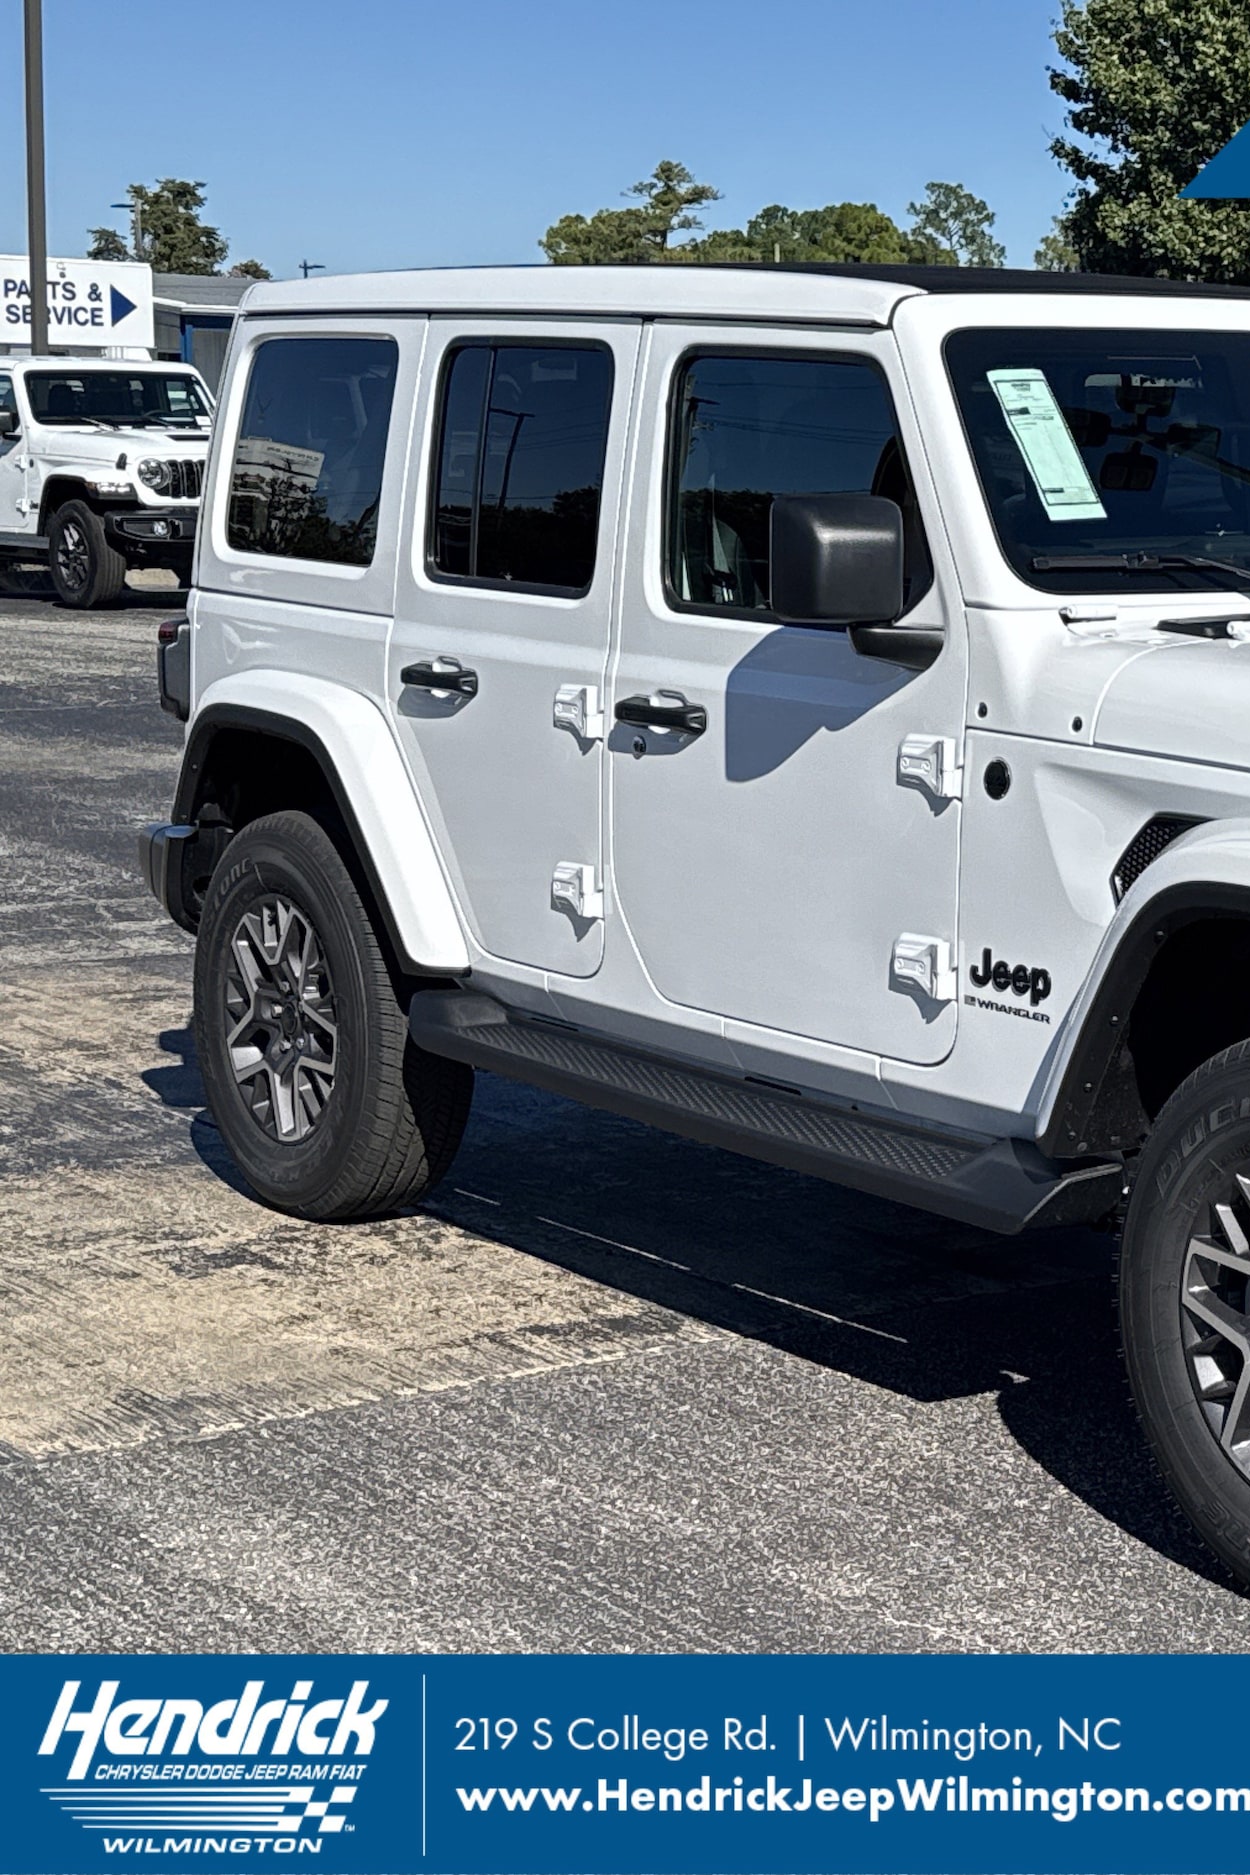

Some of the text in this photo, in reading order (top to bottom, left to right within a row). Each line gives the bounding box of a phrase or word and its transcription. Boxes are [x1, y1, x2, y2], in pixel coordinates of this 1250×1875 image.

[3, 279, 103, 302] PATS &
[5, 304, 104, 326] SEVICE
[969, 947, 1052, 1007] Jeep
[976, 998, 1050, 1025] WRANGLER
